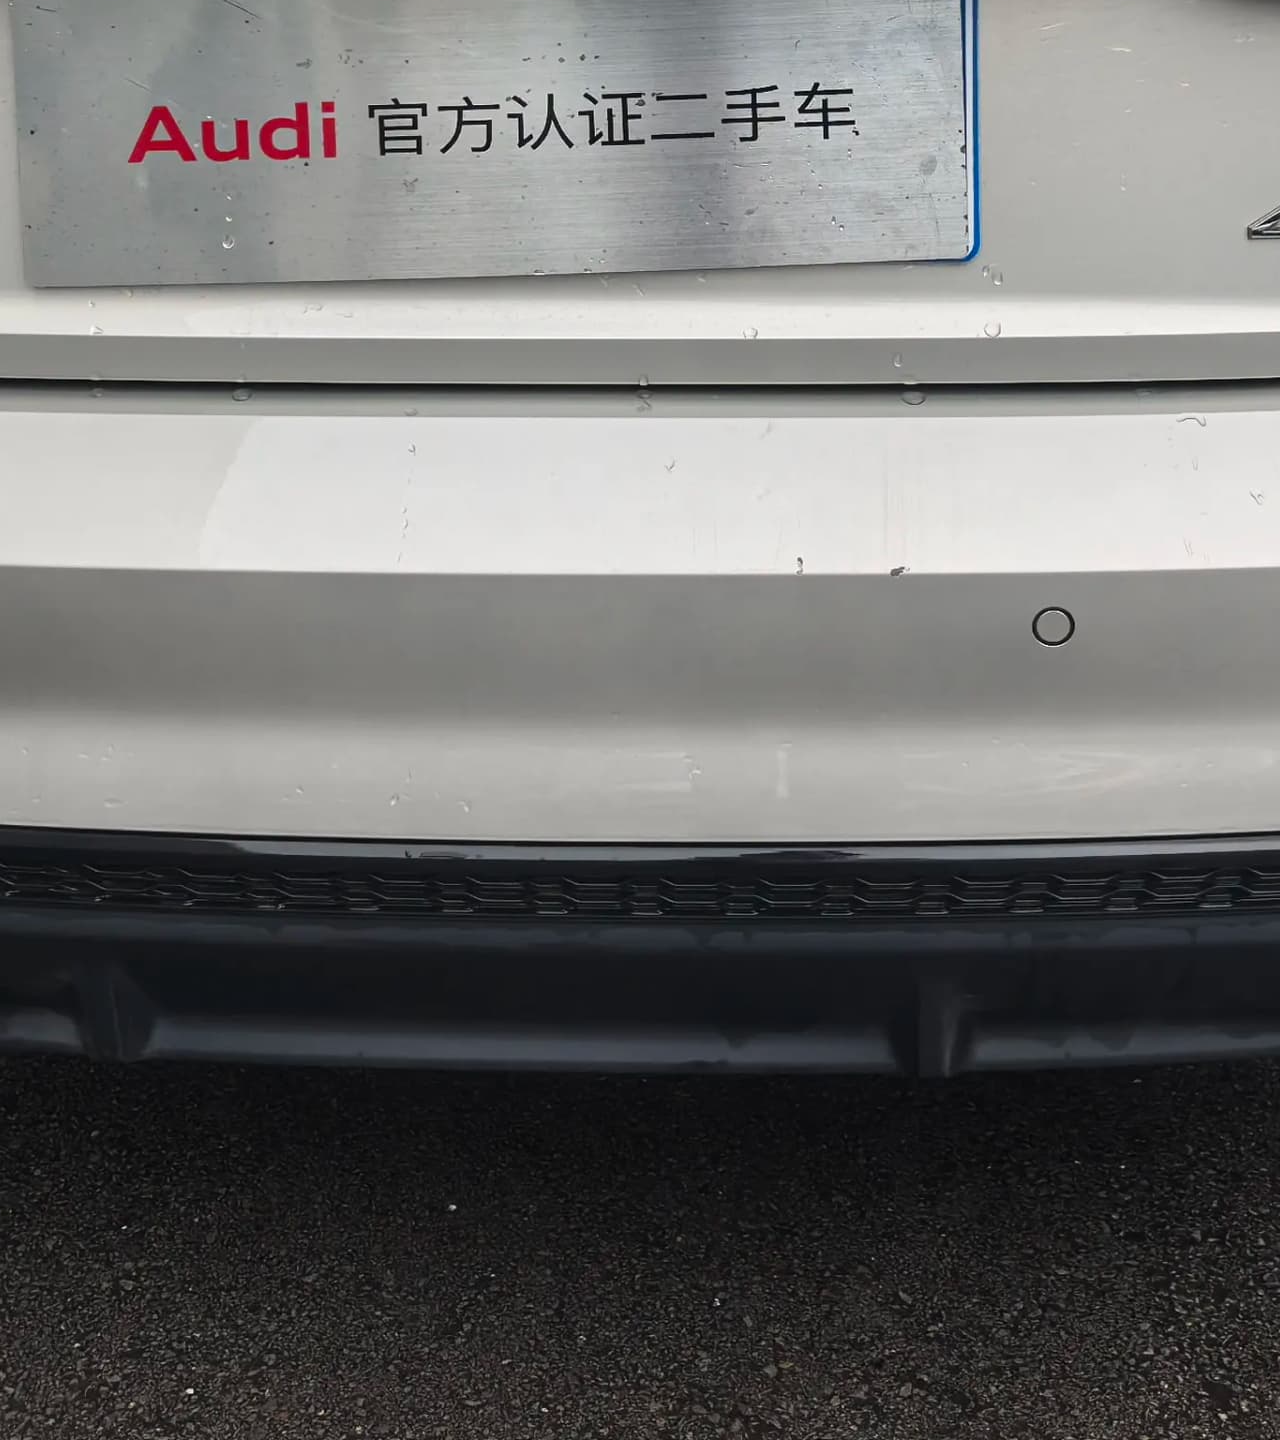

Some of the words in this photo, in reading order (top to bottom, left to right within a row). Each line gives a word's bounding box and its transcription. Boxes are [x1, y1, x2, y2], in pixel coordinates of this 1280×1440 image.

[128, 101, 338, 165] Audi
[367, 82, 856, 156] 官方认证二手车
